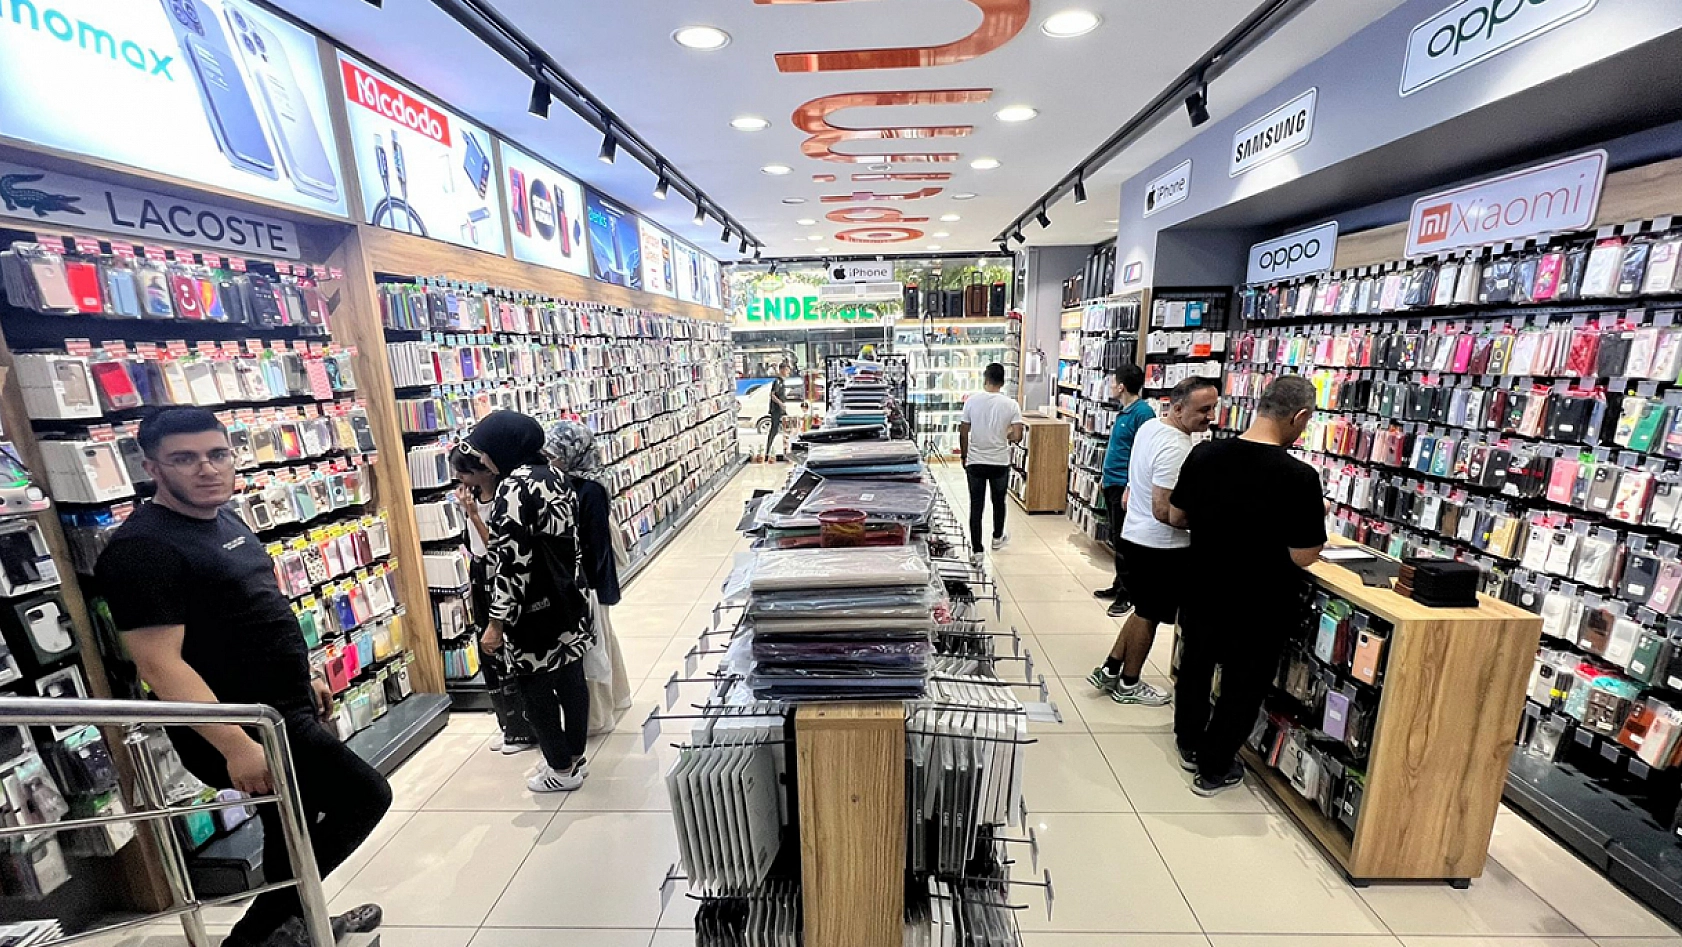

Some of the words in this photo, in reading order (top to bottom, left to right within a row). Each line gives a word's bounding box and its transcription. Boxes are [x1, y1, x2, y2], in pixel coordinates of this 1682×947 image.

[1427, 0, 1547, 58] opp
[354, 69, 443, 140] Mcdodo
[1235, 109, 1306, 164] SAMSUNG
[1156, 177, 1186, 201] iPhone
[1451, 173, 1586, 237] Xiaomi
[105, 191, 288, 252] LACOSTE
[849, 267, 888, 277] iPhone
[1259, 238, 1320, 273] oppo
